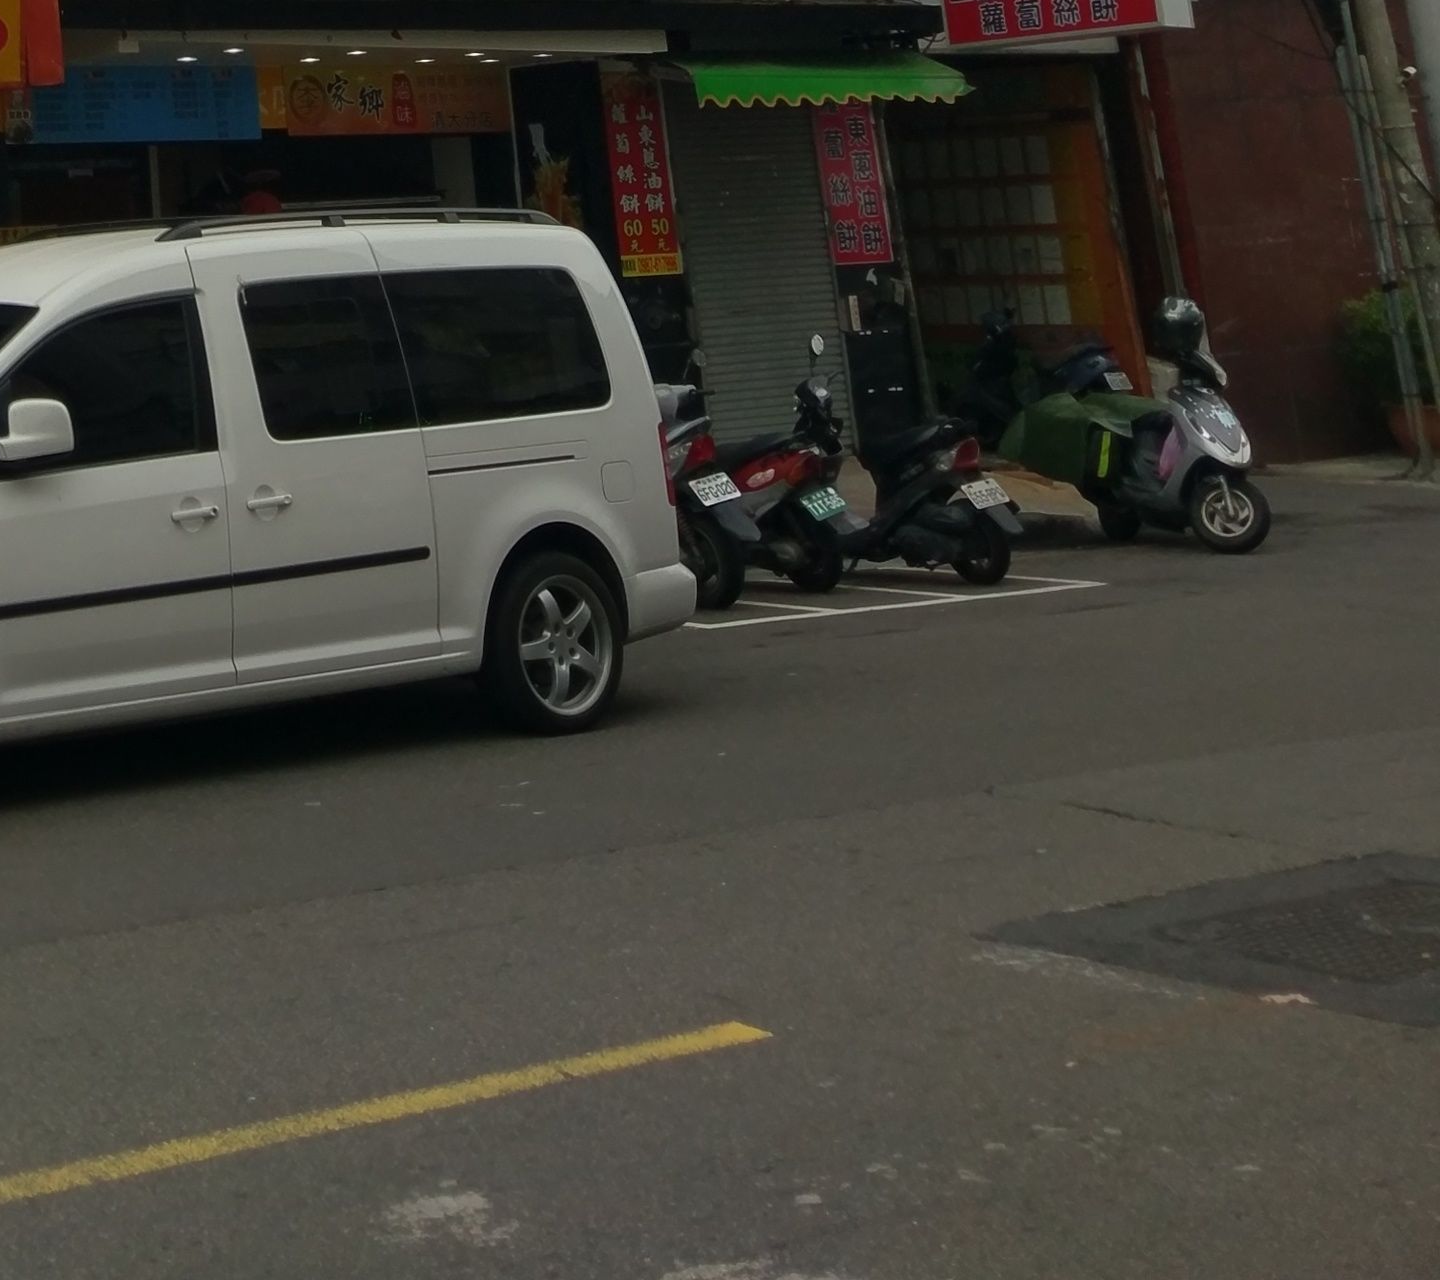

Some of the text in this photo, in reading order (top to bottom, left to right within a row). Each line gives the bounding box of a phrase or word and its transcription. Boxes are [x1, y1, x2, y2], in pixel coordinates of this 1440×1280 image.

[327, 74, 385, 126] 家鄉
[623, 219, 643, 237] 60
[650, 218, 670, 236] 50
